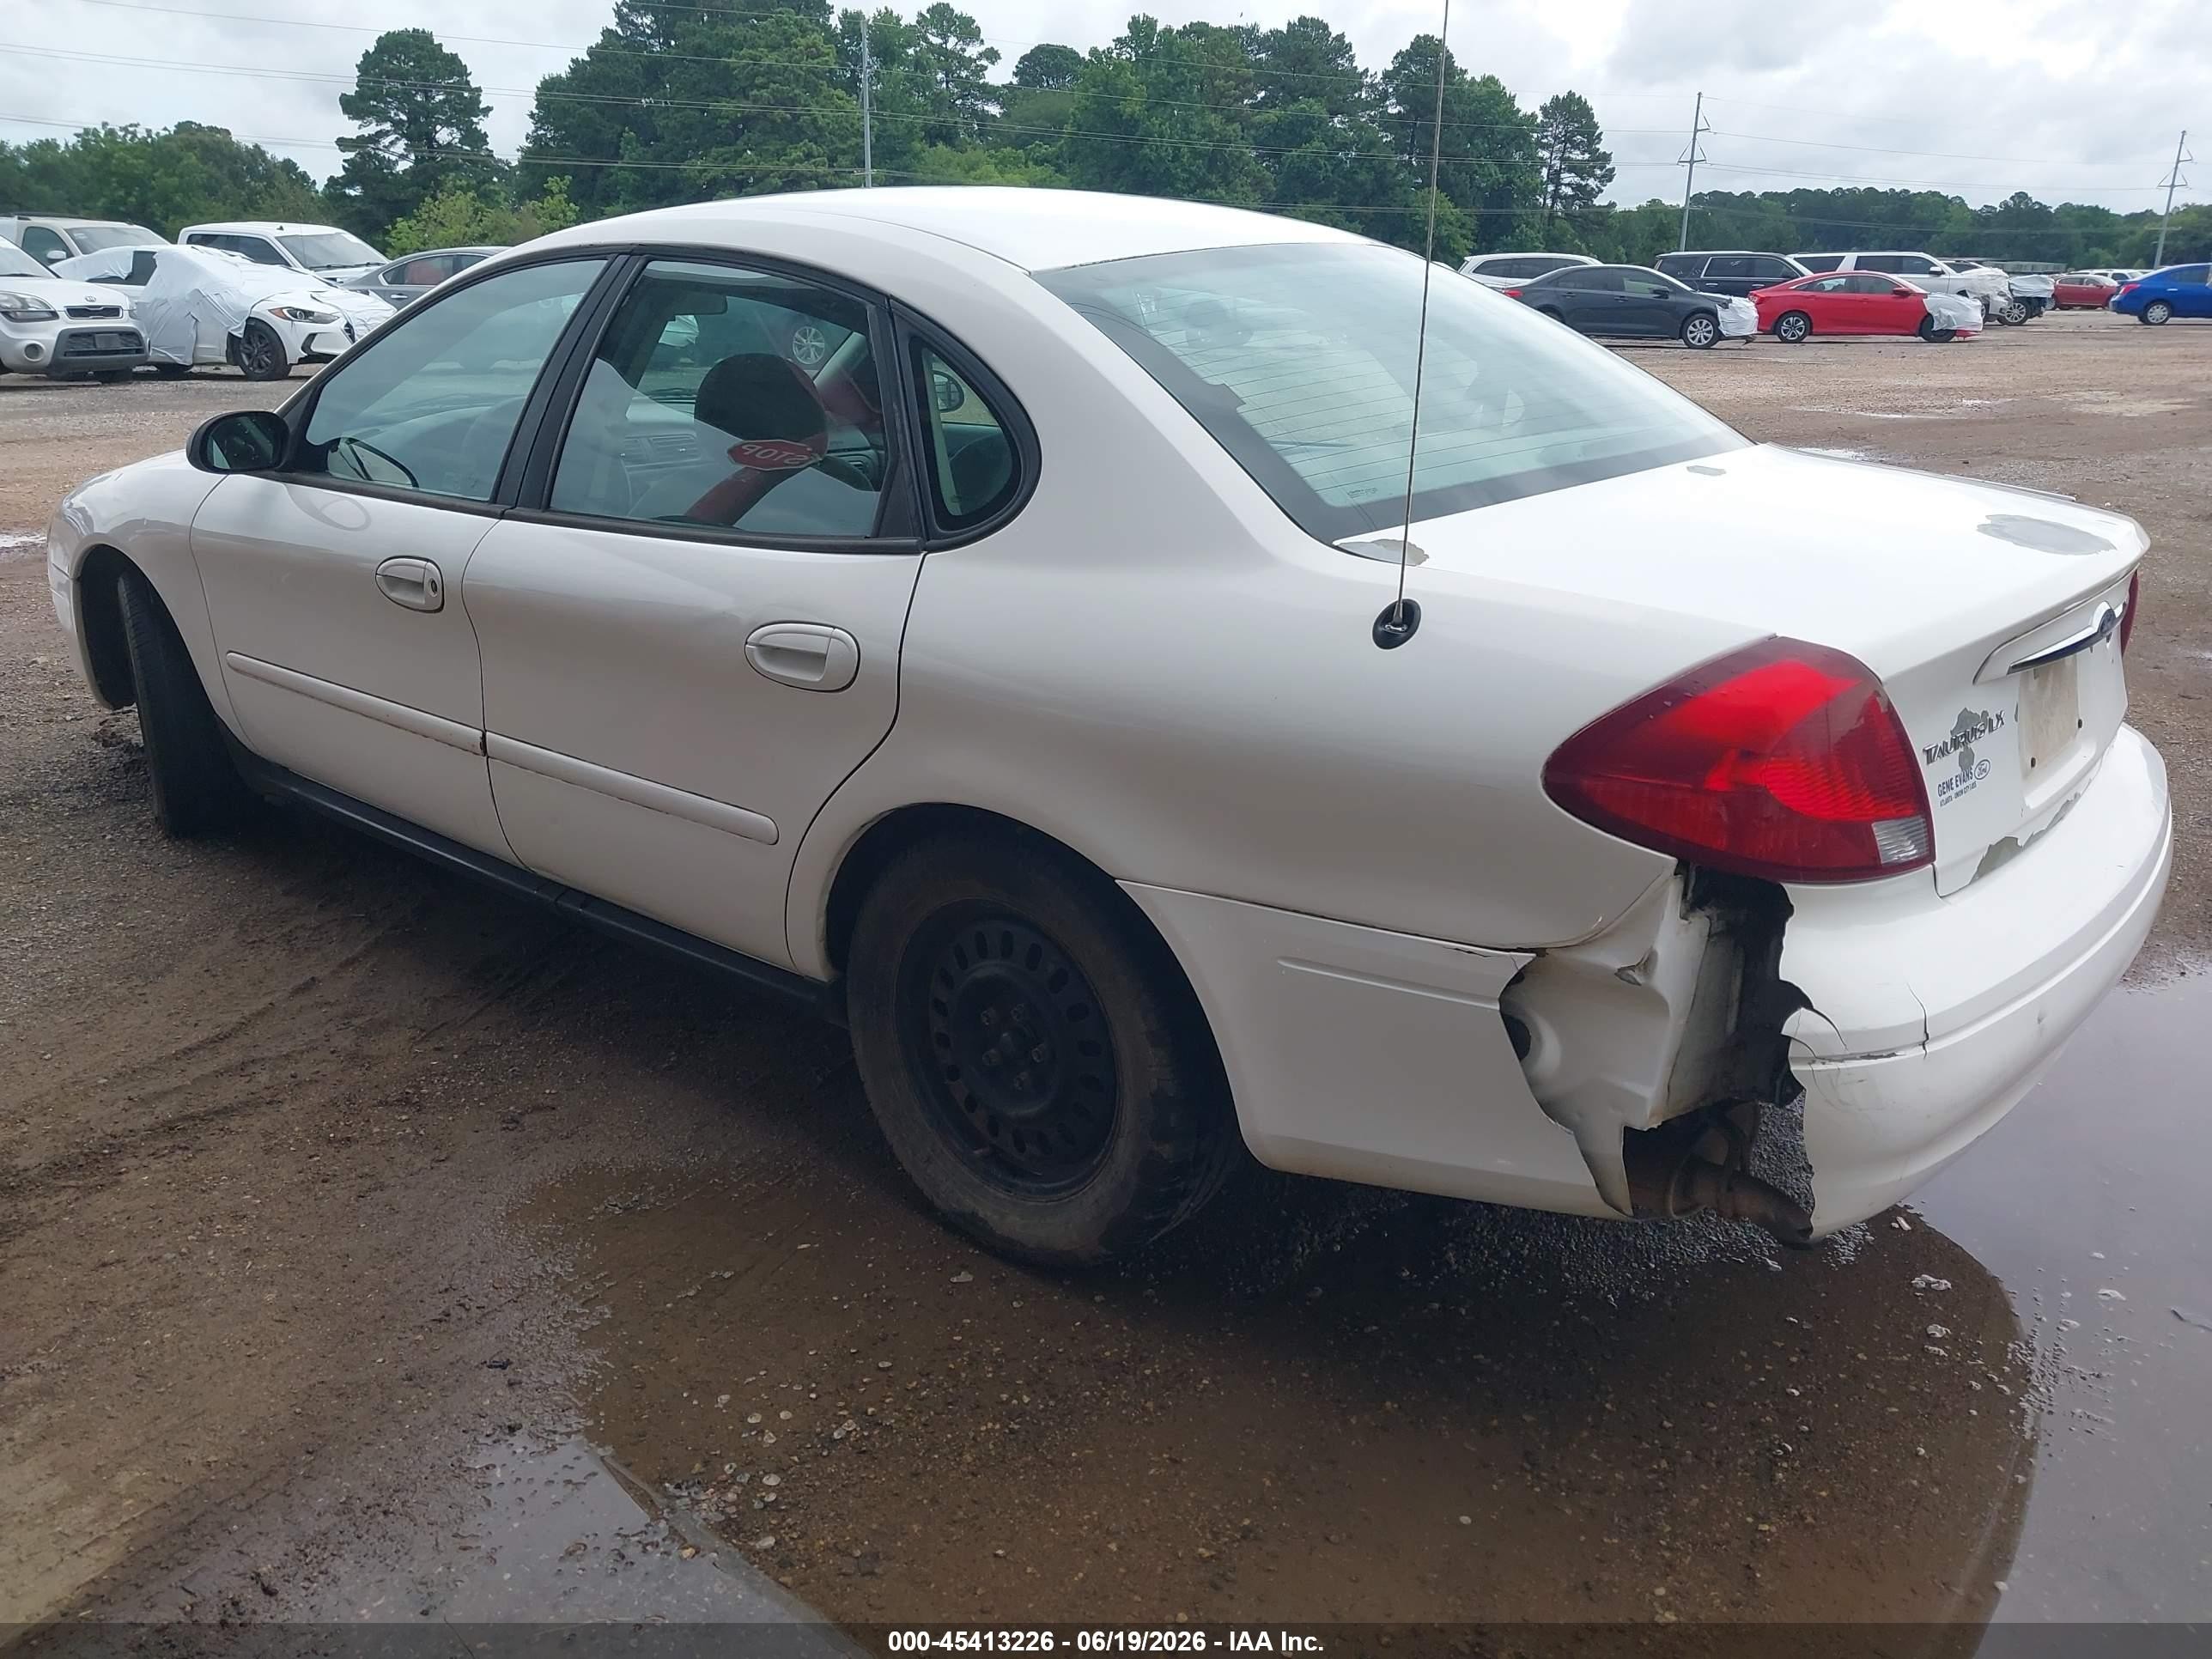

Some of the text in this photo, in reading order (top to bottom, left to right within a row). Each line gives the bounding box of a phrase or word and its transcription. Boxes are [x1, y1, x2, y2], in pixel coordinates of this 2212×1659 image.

[1923, 710, 2005, 765] TAURUS LX
[1937, 777, 1954, 798] GENE
[1954, 767, 1973, 788] EVANS
